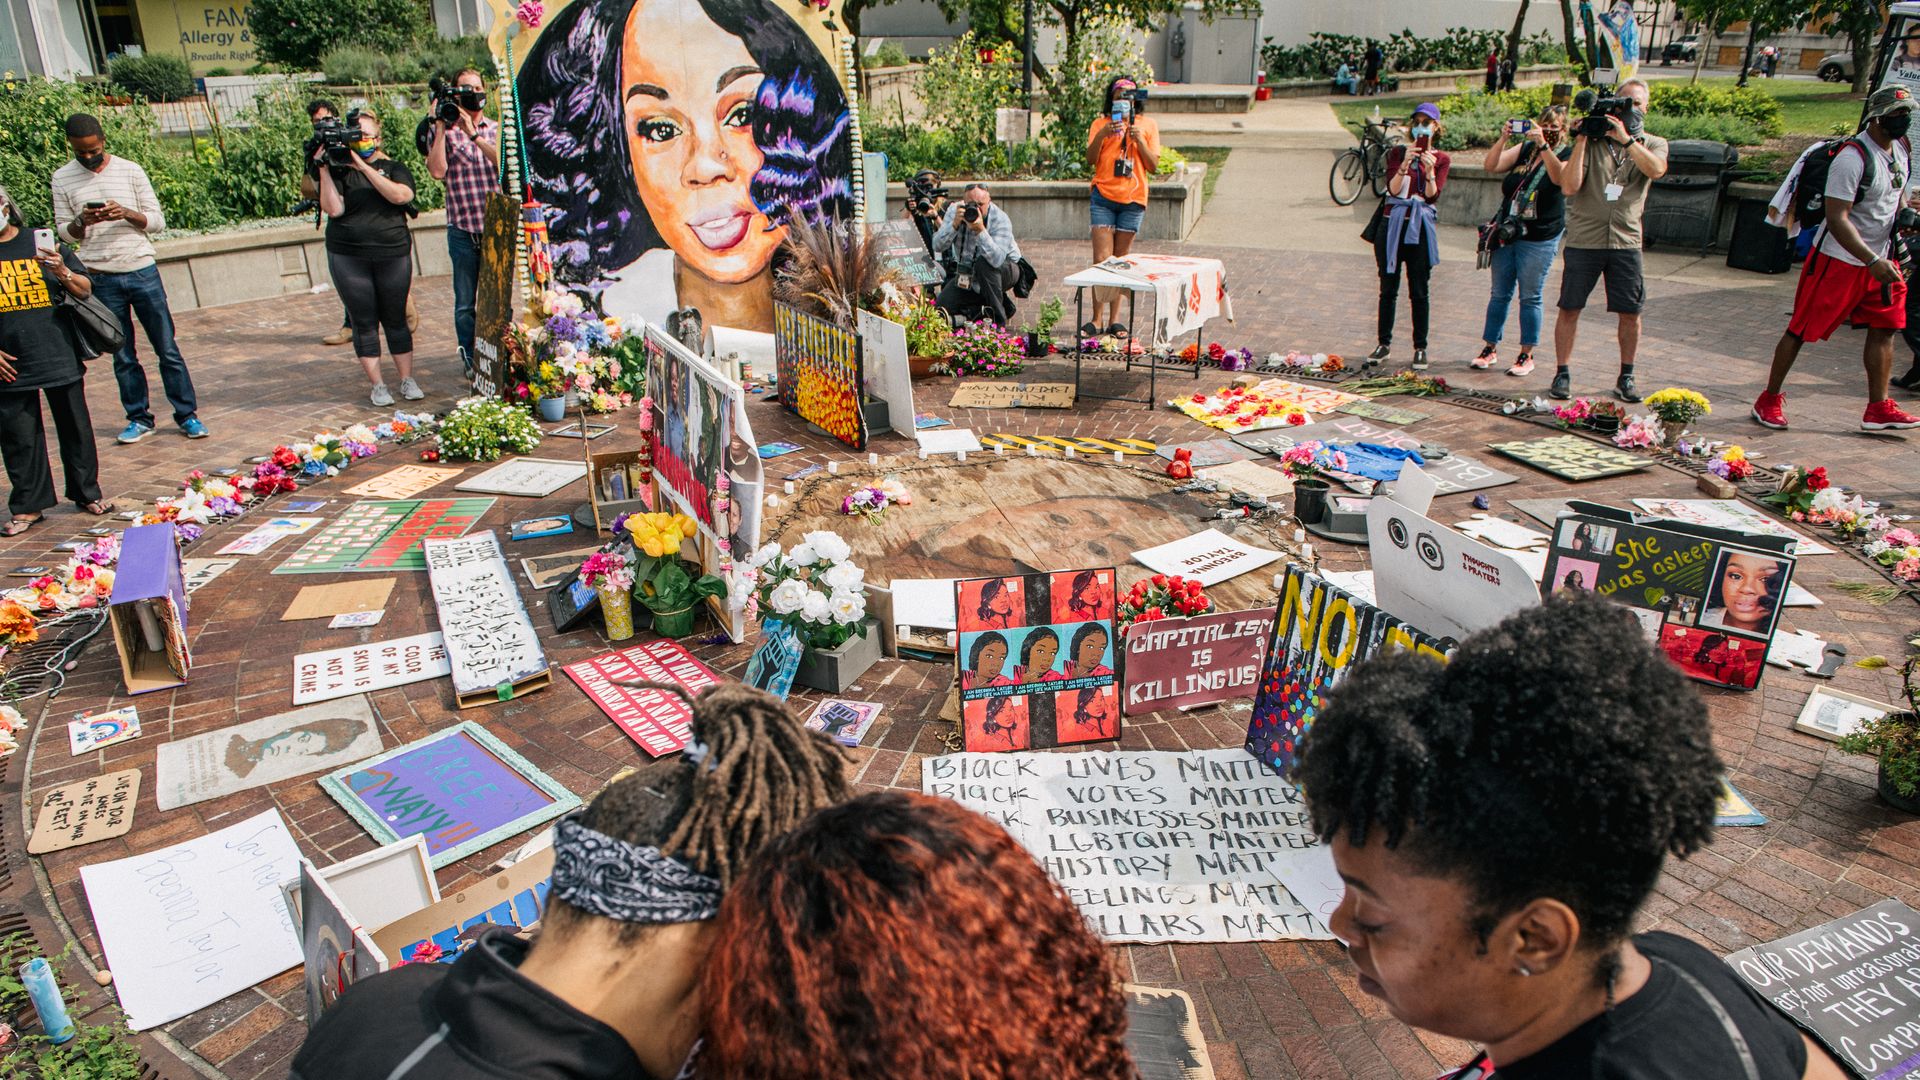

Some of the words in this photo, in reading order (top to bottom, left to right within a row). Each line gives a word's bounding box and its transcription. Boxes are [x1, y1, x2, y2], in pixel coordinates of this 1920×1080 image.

[180, 30, 235, 46] Allergy
[240, 29, 250, 42] &
[191, 52, 226, 61] Breathe
[0, 259, 42, 277] ACK
[0, 274, 47, 294] VES
[0, 289, 50, 307] ATTER
[428, 545, 453, 569] FORCE
[452, 541, 477, 566] FATAL
[474, 540, 499, 562] FUCK
[1180, 547, 1235, 566] TAYLOR
[1614, 536, 1662, 569] She
[1187, 551, 1248, 575] BREONNA
[1462, 552, 1500, 576] THOUGHTS
[1597, 568, 1647, 596] was
[1652, 541, 1714, 576] asleep
[1468, 565, 1501, 586] PRAYERS
[1277, 573, 1357, 670] NO
[1132, 618, 1275, 654] CAPITALISM
[353, 649, 369, 672] SKIN
[382, 646, 397, 658] OF
[405, 645, 422, 674] COLOR
[428, 644, 446, 662] THE
[645, 641, 688, 665] SAY
[1191, 648, 1213, 668] IS
[327, 657, 343, 677] NOT
[383, 663, 400, 676] MY
[594, 655, 639, 679] SAY
[300, 664, 318, 694] CRIME
[327, 682, 343, 690] A
[354, 677, 371, 687] IS
[570, 661, 632, 712] BREONNA
[617, 706, 678, 752] TAYLOR
[1065, 756, 1156, 781] LIVES
[1177, 756, 1280, 783] MATTE
[80, 793, 94, 807] DIE
[95, 794, 111, 820] KNEES
[112, 791, 128, 804] ON
[1066, 785, 1167, 805] VOTES
[1190, 785, 1306, 808] MATTER
[51, 800, 74, 832] FEET?
[77, 809, 89, 821] ON
[1046, 808, 1216, 830] BUSINESSES
[217, 824, 278, 874] Say
[1049, 831, 1196, 851] LGBTQIA
[1209, 830, 1320, 850] MATTER
[1043, 853, 1172, 880] HISTORY
[1195, 851, 1279, 876] MATT
[1063, 885, 1196, 907] EELINGS
[1084, 913, 1206, 937] LLARS
[1740, 952, 1801, 987] OUR
[1785, 911, 1910, 974] DEMANDS
[1800, 979, 1834, 1003] not
[1822, 982, 1907, 1027] THEY
